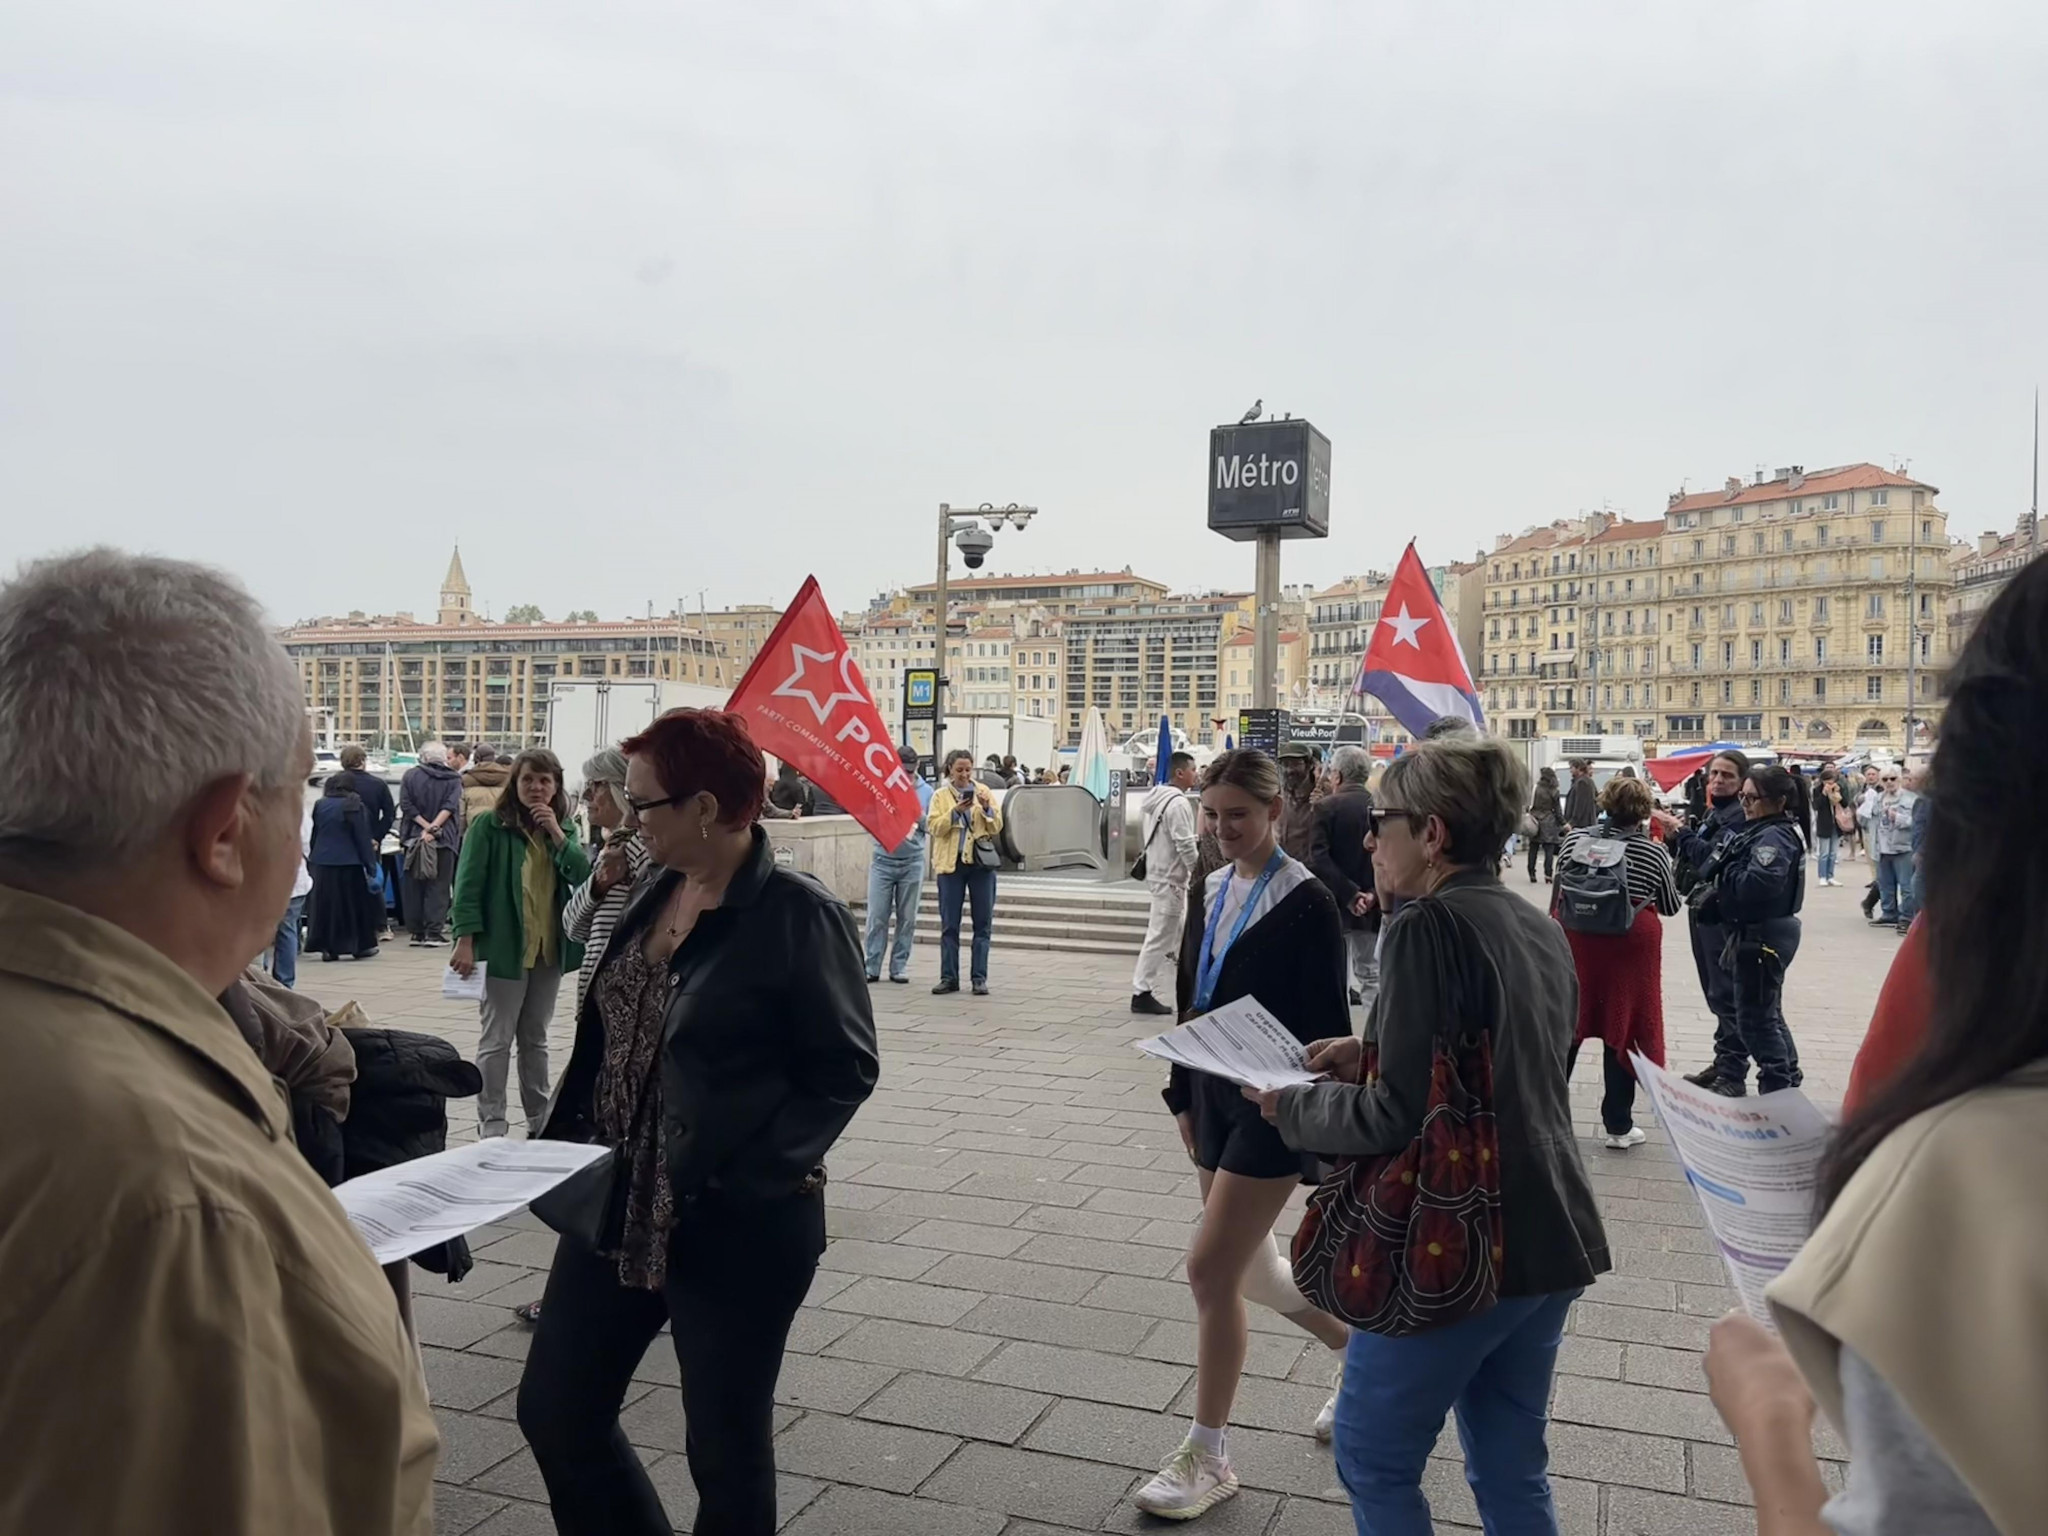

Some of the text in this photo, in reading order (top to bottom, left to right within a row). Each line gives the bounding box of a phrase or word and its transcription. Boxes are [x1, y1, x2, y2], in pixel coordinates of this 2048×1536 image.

[1216, 453, 1299, 489] Métro
[913, 685, 930, 697] M1
[756, 704, 896, 814] PARTI COMMUNISTE FRANÇAIS
[835, 715, 911, 792] PCF
[1256, 1012, 1290, 1045] Urgences
